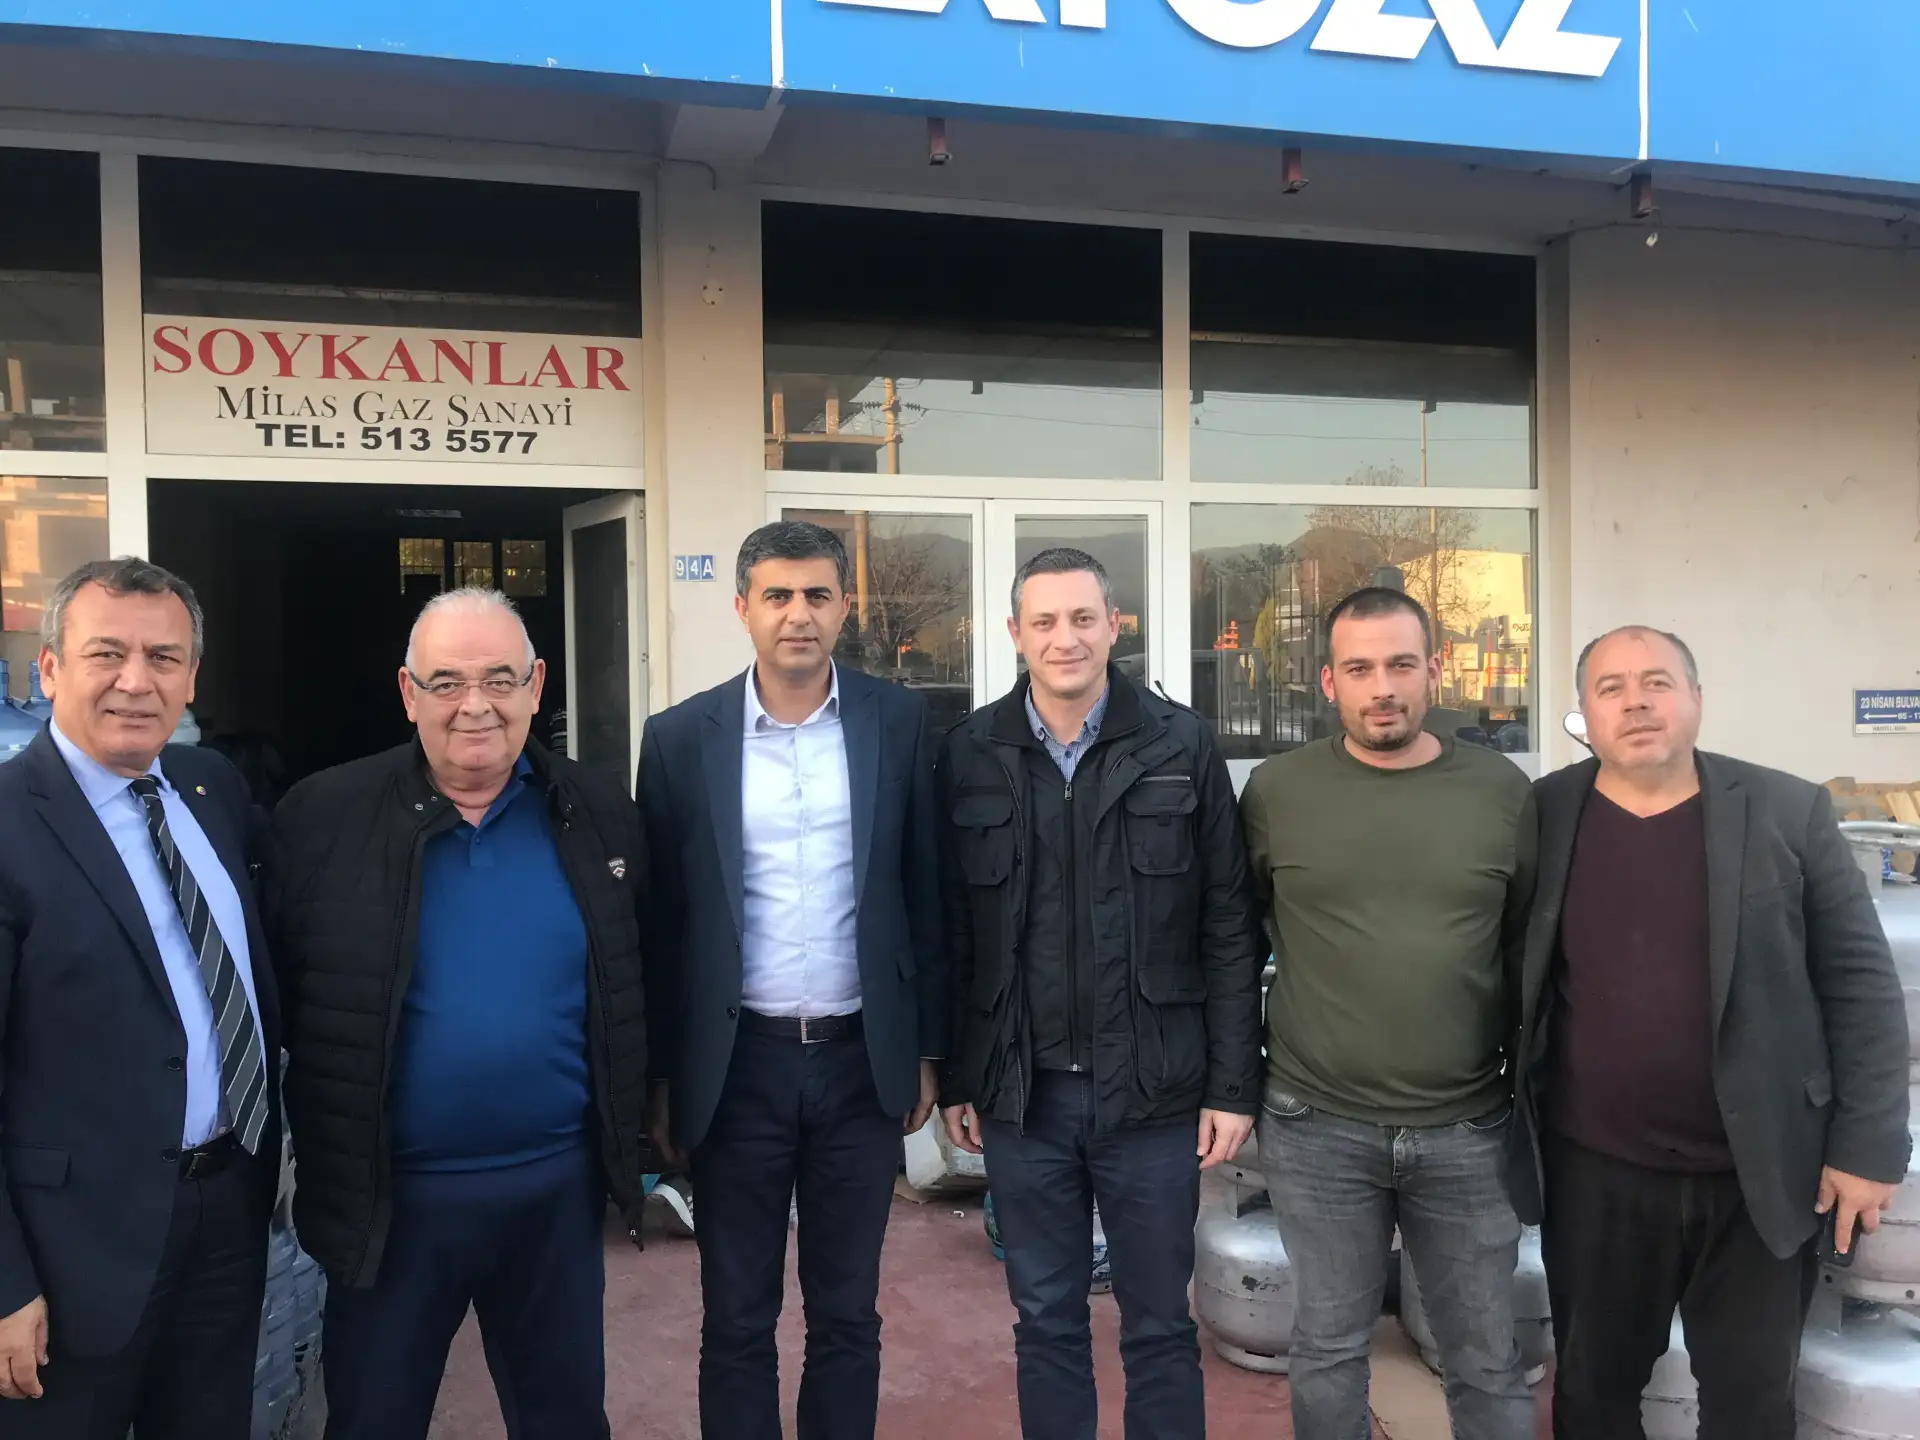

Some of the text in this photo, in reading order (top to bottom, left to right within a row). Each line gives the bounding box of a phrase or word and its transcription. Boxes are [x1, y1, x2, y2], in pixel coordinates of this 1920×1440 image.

[153, 325, 631, 391] SOYKANLAR
[214, 385, 573, 427] MİLAS GAZ SANAYİ
[255, 423, 538, 454] TEL: 513 5577
[675, 558, 714, 577] 94A
[1860, 697, 1870, 709] 23
[1871, 692, 1895, 709] NİSAN
